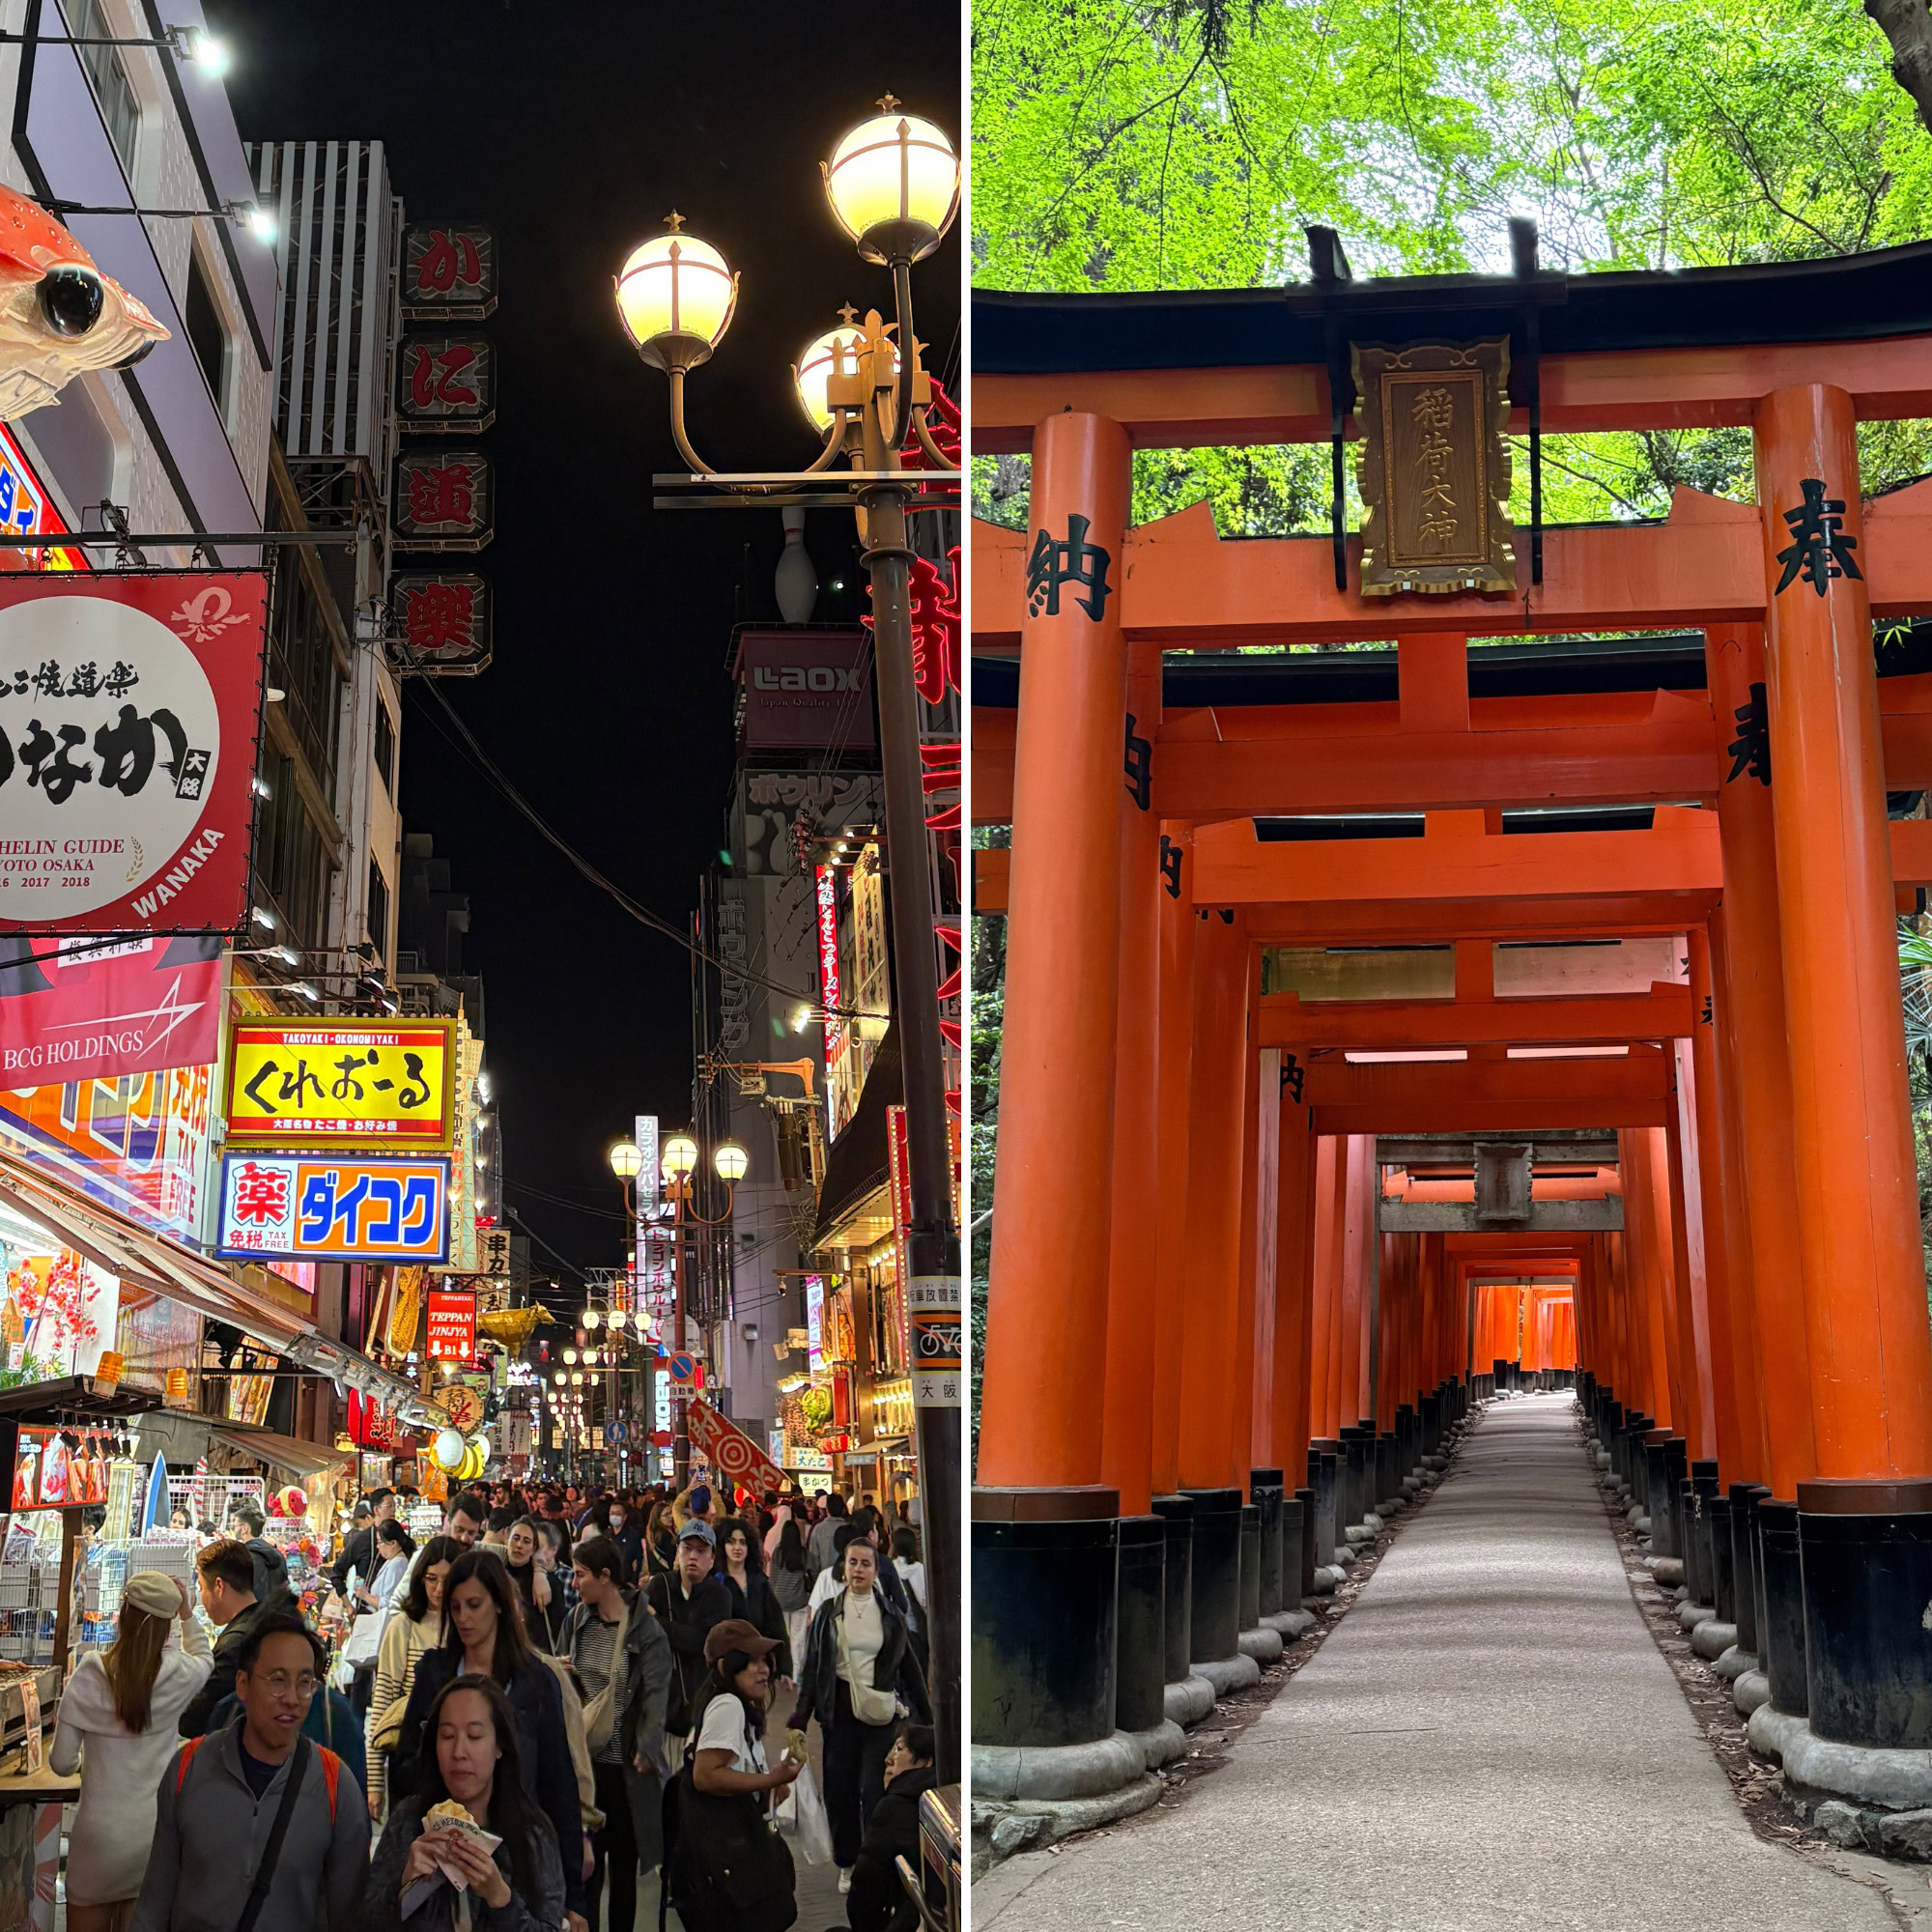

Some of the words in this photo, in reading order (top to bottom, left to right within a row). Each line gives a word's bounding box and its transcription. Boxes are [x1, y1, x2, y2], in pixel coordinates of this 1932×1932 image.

[1410, 387, 1458, 541] 稲荷大神
[1774, 478, 1864, 598] 奉
[1026, 513, 1113, 622] 納
[179, 752, 207, 797] 大阪
[43, 859, 95, 871] OSAKA
[64, 838, 125, 854] GUIDE
[20, 877, 50, 888] 2017
[61, 876, 91, 888] 2018
[130, 827, 227, 920] WANAKA
[4, 1046, 43, 1070] BCG
[46, 1030, 144, 1065] HOLDINGS
[243, 1048, 431, 1115] くれおーる
[272, 1120, 311, 1129] 大阪名物
[178, 1127, 197, 1179] TAX
[169, 1171, 196, 1224] FREE
[236, 1164, 287, 1224] 薬
[300, 1172, 437, 1247] ダイコク
[229, 1229, 263, 1249] 免税
[265, 1240, 289, 1249] FREE
[268, 1232, 287, 1240] TAX
[429, 1326, 469, 1337] JINJYA
[430, 1312, 473, 1322] TEPPAN
[444, 1345, 456, 1355] B1
